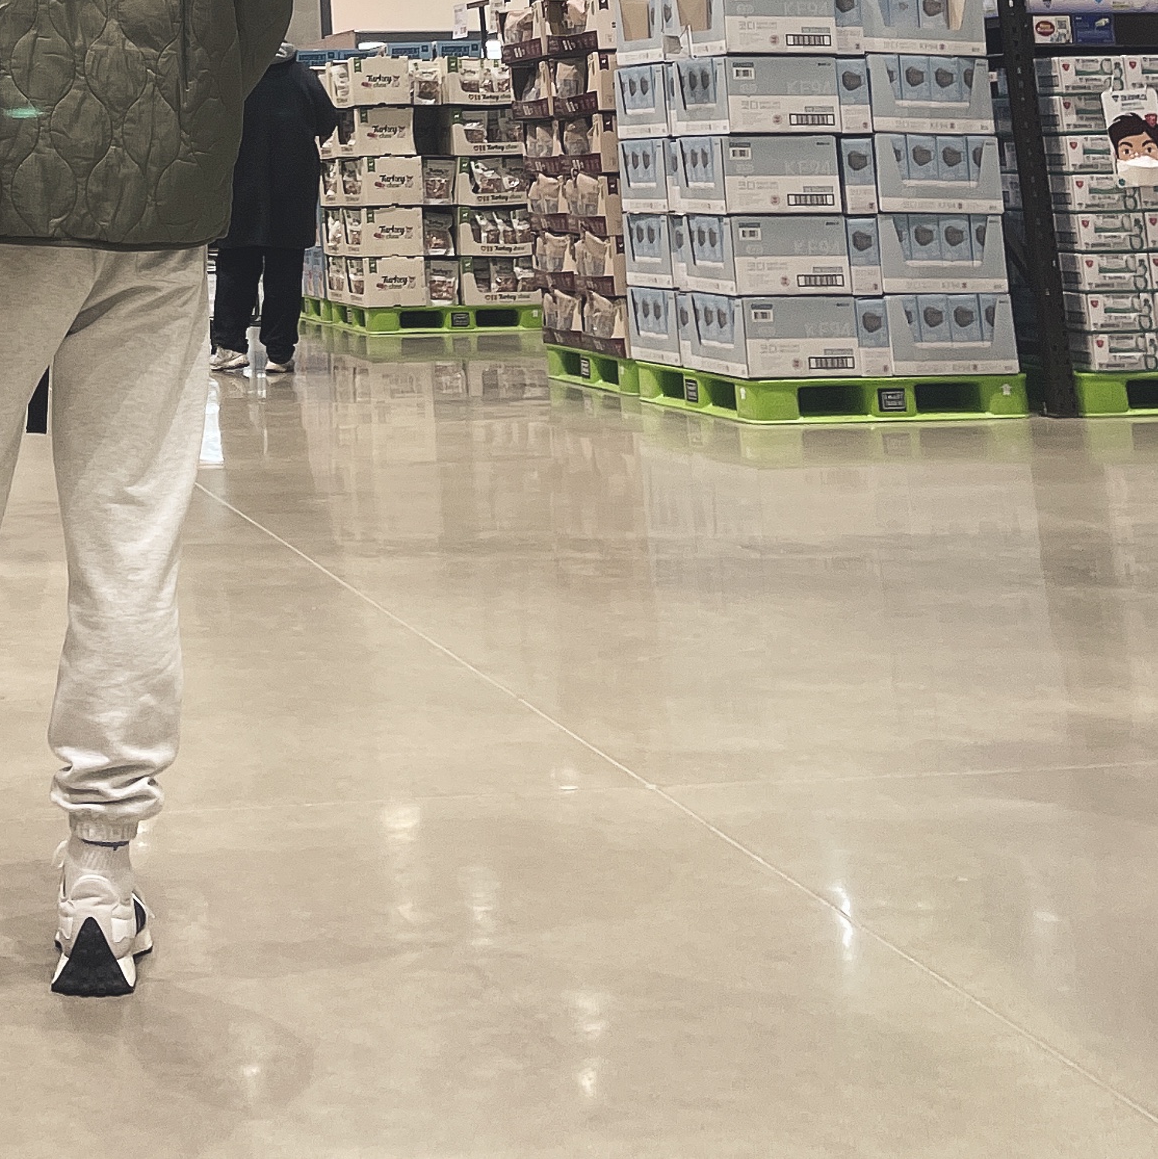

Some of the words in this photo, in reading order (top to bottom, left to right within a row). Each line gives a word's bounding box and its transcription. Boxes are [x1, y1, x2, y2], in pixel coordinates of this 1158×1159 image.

[366, 74, 392, 83] Turkey
[482, 93, 499, 101] Turkey
[372, 125, 398, 133] Turkey
[487, 144, 505, 152] Turkey
[380, 174, 405, 184] Turkey
[379, 225, 405, 235] Turkey
[381, 275, 408, 285] Turkey
